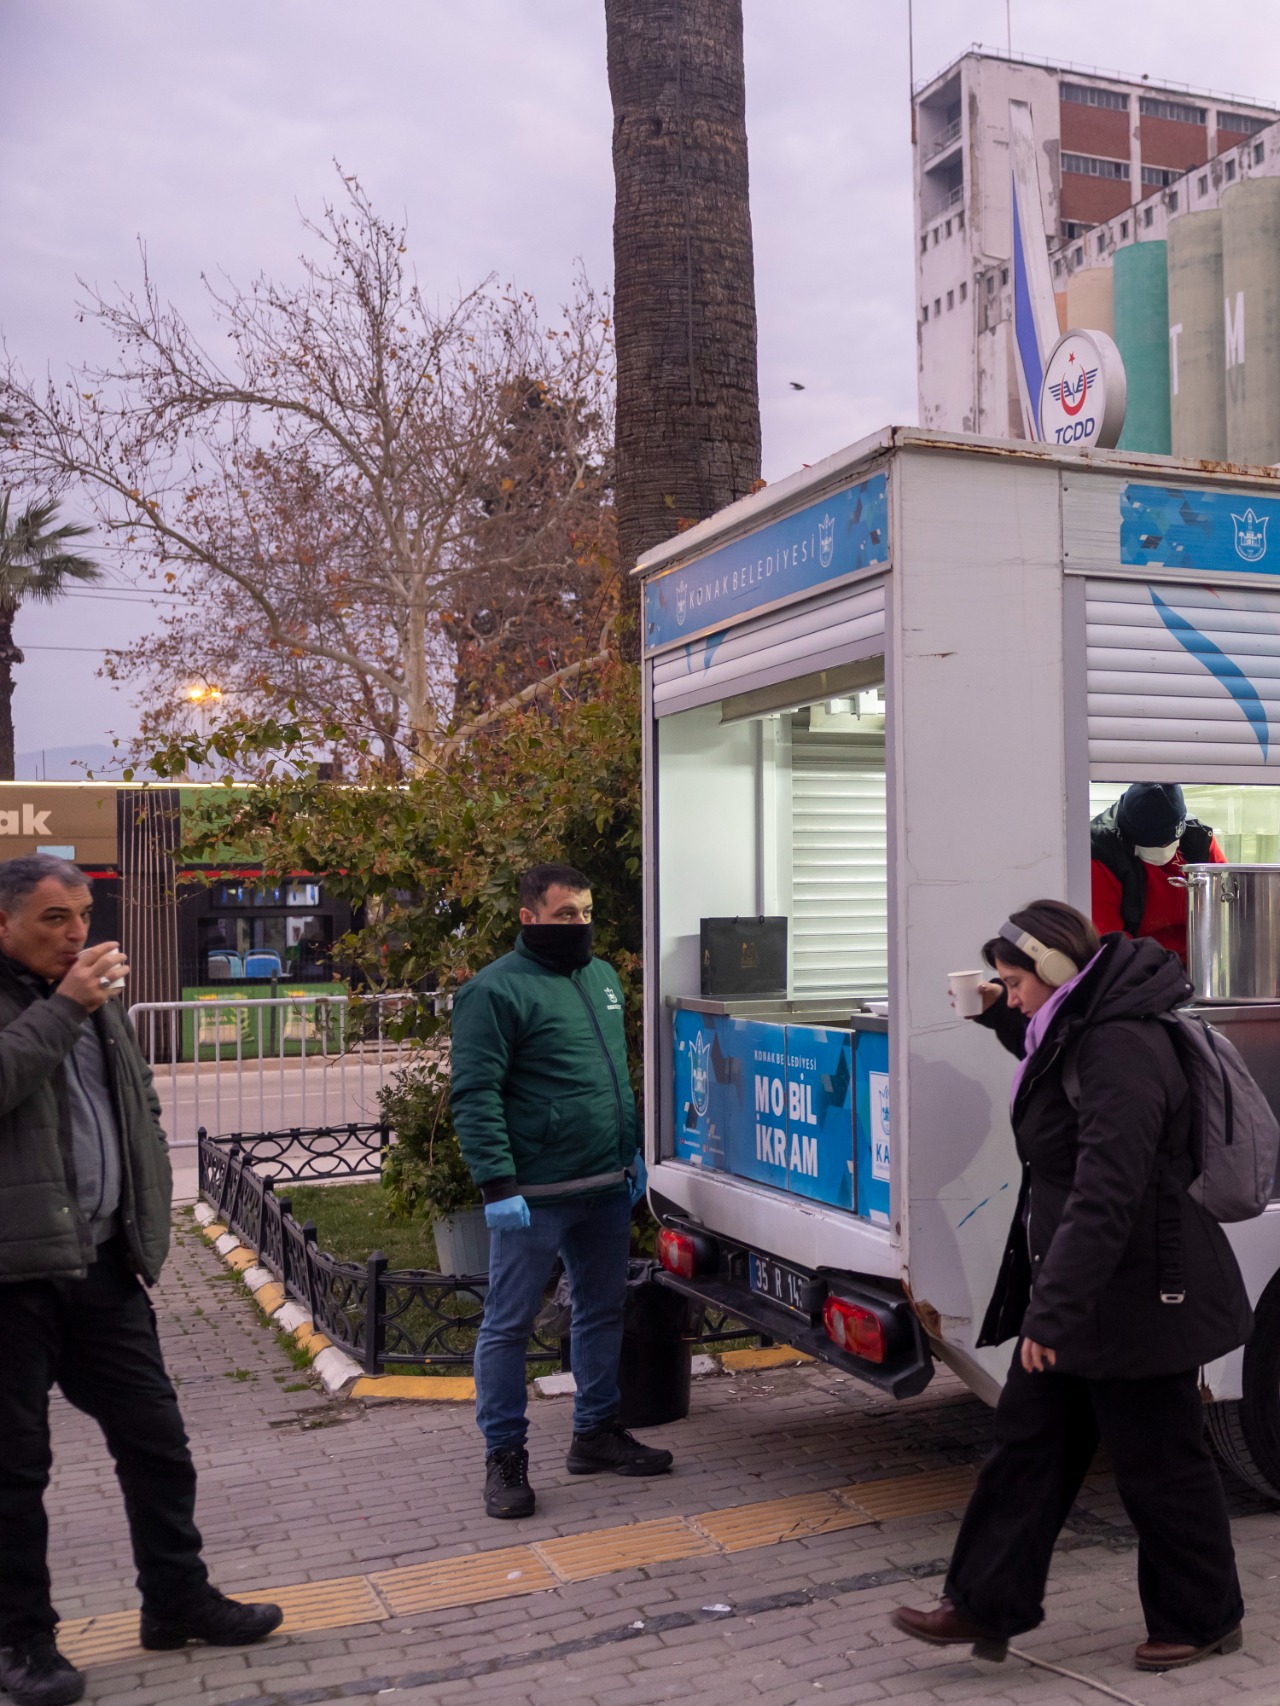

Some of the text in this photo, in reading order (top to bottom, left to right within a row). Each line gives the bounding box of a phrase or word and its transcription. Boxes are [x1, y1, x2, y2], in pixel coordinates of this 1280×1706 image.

[1055, 417, 1095, 445] TCDD
[689, 533, 815, 609] KONAK BELEDİYESİ
[754, 1049, 817, 1071] KONAK BELEDİYESİ
[755, 1073, 817, 1125] MOBİL
[755, 1114, 818, 1178] İKRAM
[756, 1259, 768, 1291] 35
[774, 1267, 782, 1298] R
